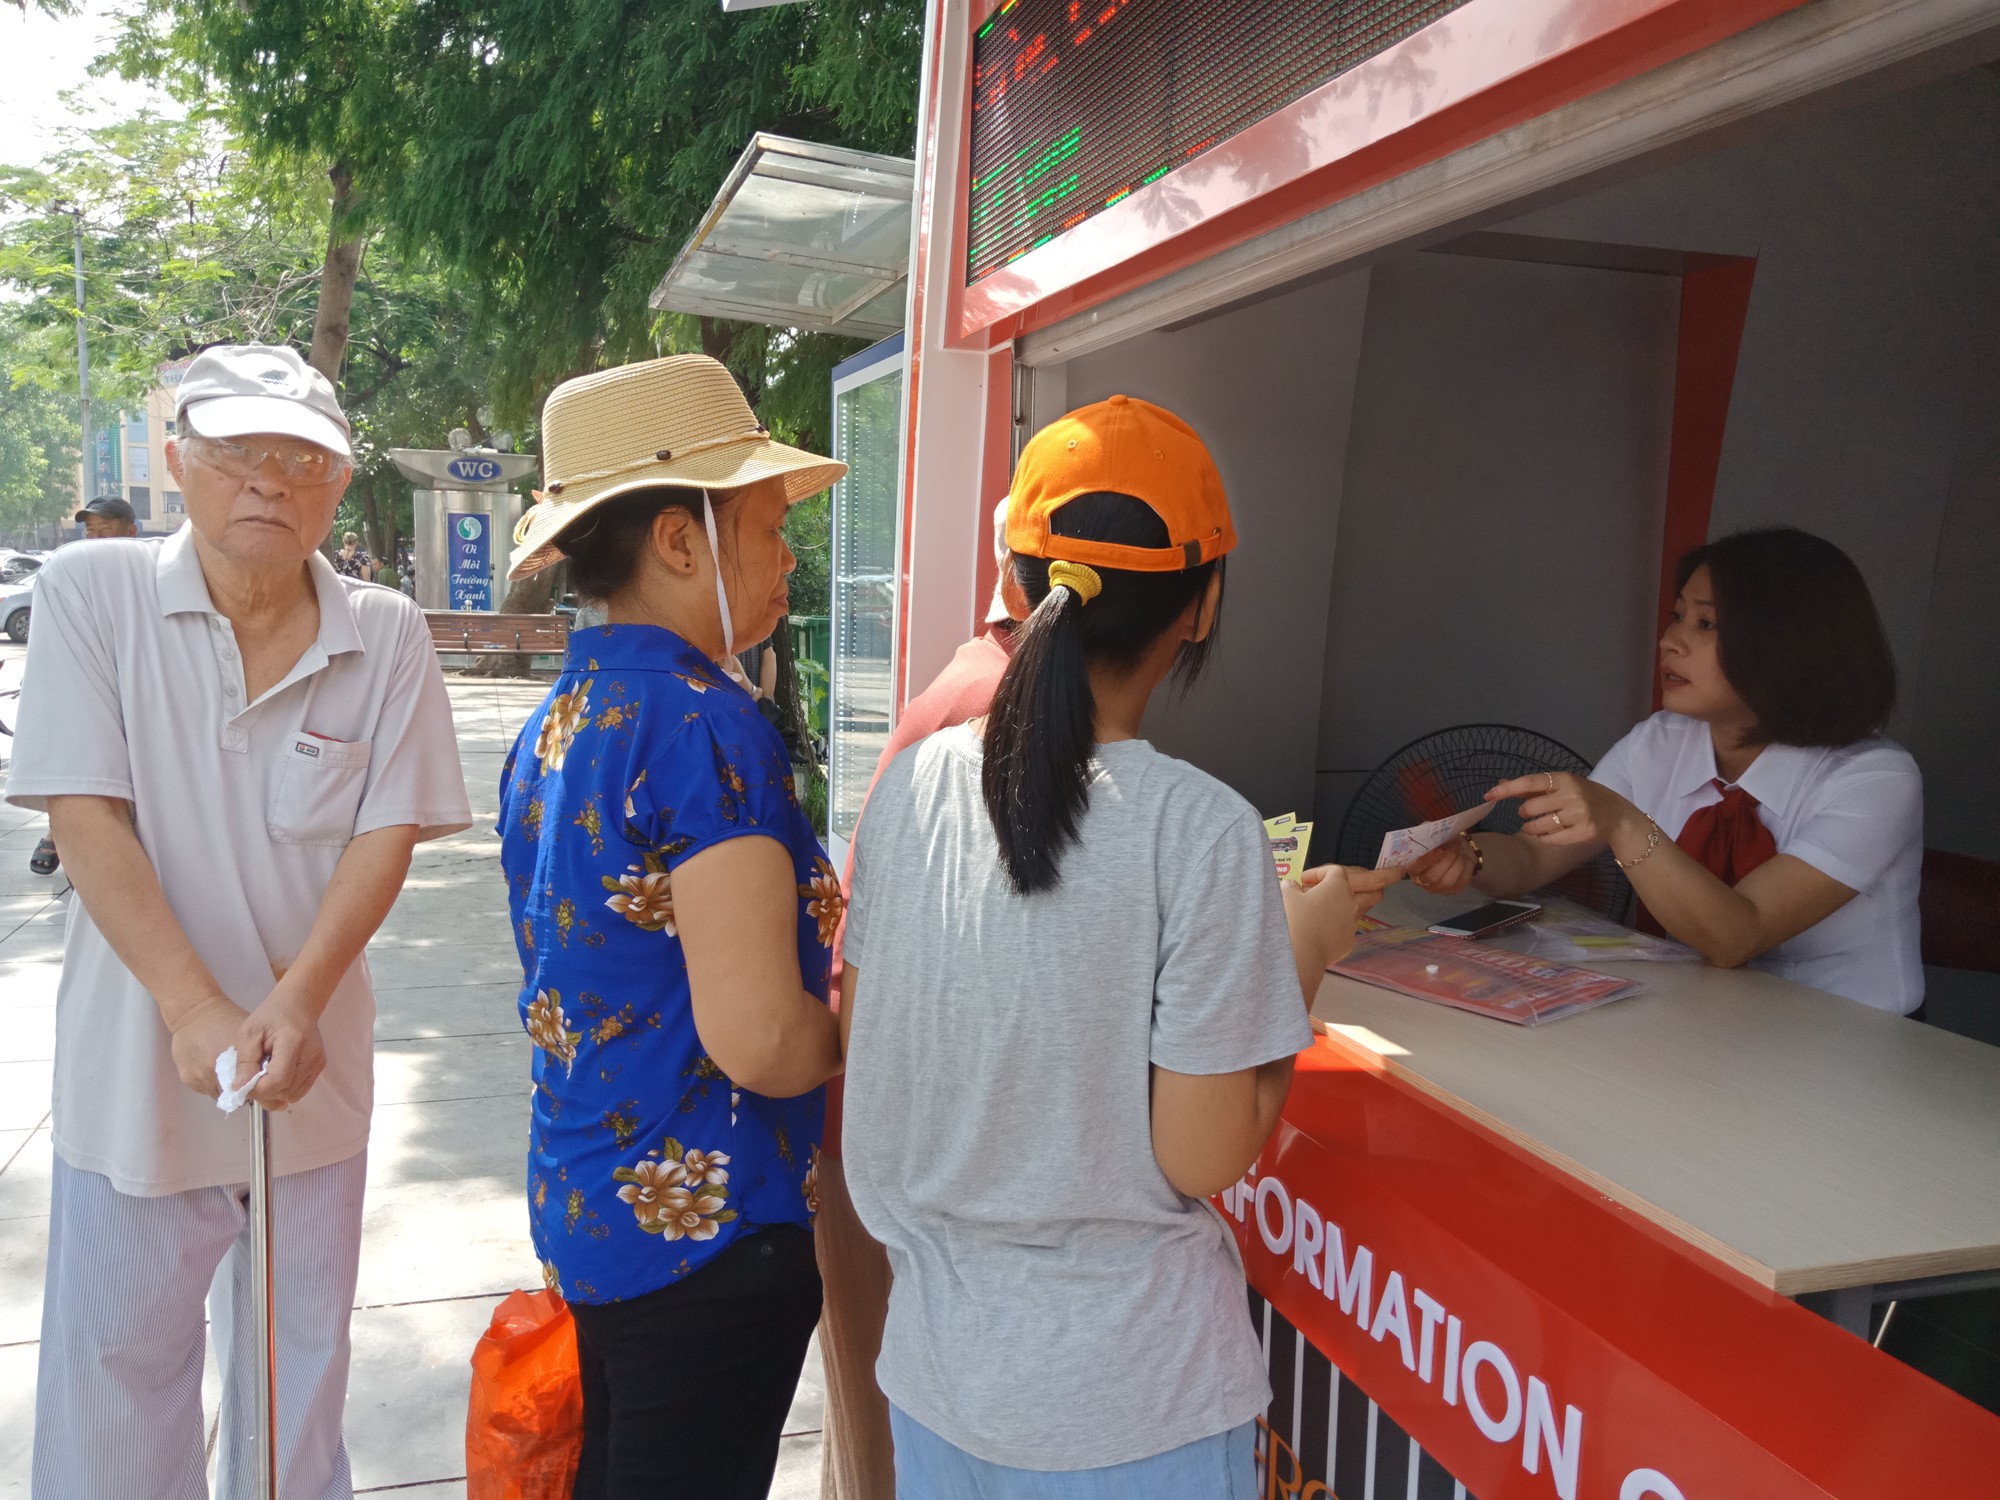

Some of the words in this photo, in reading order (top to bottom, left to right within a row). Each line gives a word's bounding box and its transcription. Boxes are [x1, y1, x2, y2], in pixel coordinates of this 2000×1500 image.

[457, 461, 493, 478] WC
[462, 543, 478, 555] Vì
[458, 559, 481, 570] Môi
[451, 574, 489, 587] Trường
[455, 589, 486, 601] Xanh
